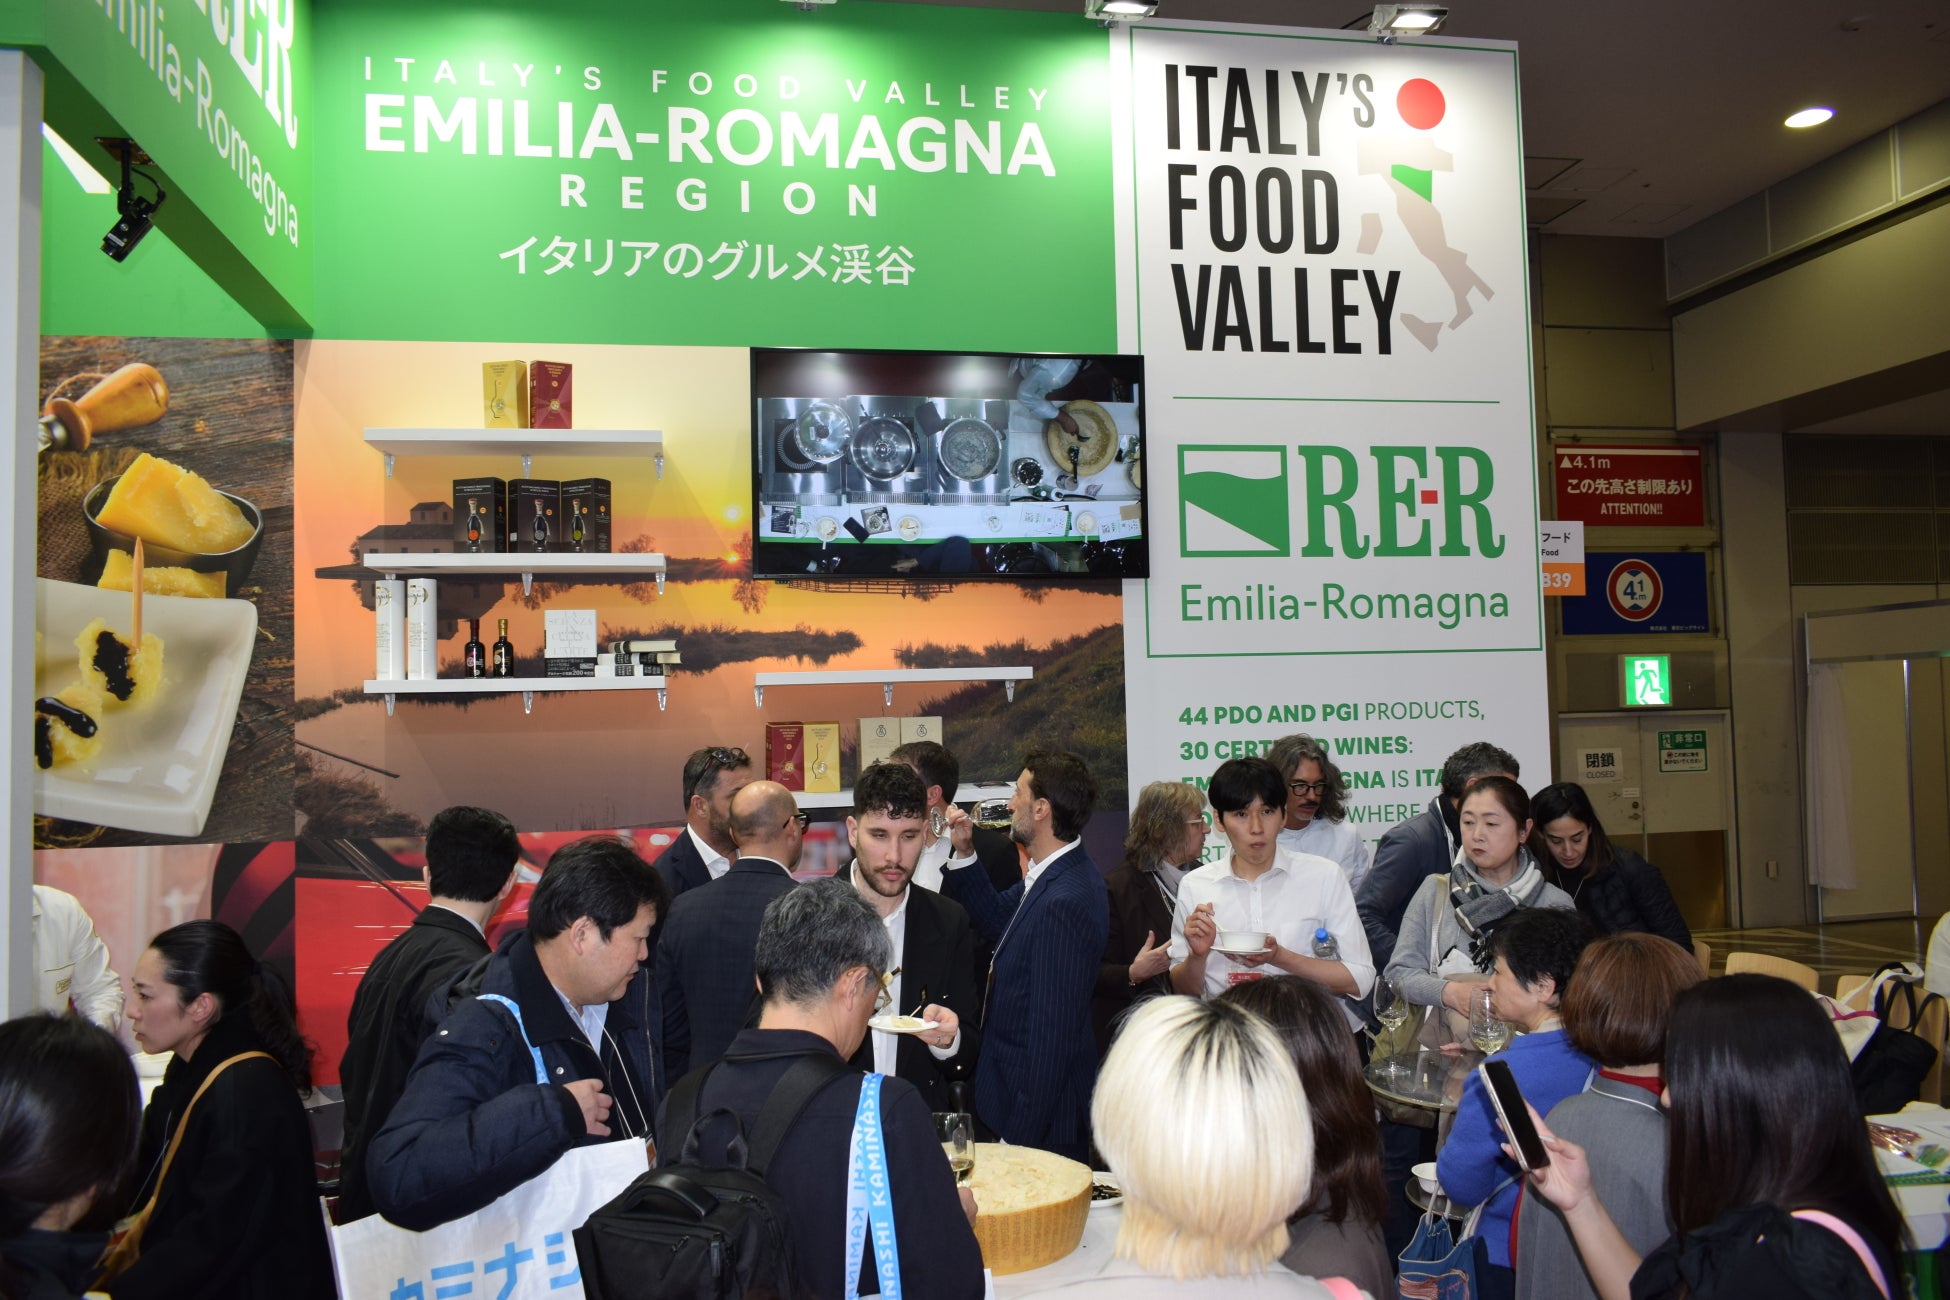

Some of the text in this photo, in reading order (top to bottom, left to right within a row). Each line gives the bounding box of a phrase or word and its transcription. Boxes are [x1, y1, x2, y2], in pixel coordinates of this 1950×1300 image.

[364, 56, 1048, 111] ITALY'S FOOD VALLEY
[93, 0, 298, 248] milia-Romagna
[1165, 63, 1375, 157] ITALY'S
[364, 92, 1057, 177] EMILIA-ROMAGNA
[559, 173, 877, 217] REGION
[1168, 163, 1340, 255] FOOD
[499, 234, 916, 286] イタリアのグルメ渓谷
[1171, 263, 1402, 356] VALLEY
[1567, 478, 1693, 495] この先高さ制限あり
[1600, 502, 1663, 515] ATTENTION!!
[1180, 583, 1510, 630] Emilia-Romagna
[1178, 700, 1486, 726] 44 PDO AND PGI PRODUCTS,
[1180, 741, 1209, 760] 30
[1334, 736, 1414, 756] WINES:
[1586, 752, 1616, 768] 閉鎖
[1392, 770, 1409, 788] IS
[1586, 770, 1616, 779] CLOSED
[1346, 803, 1420, 824] WHERE
[876, 1221, 898, 1300] NASHI
